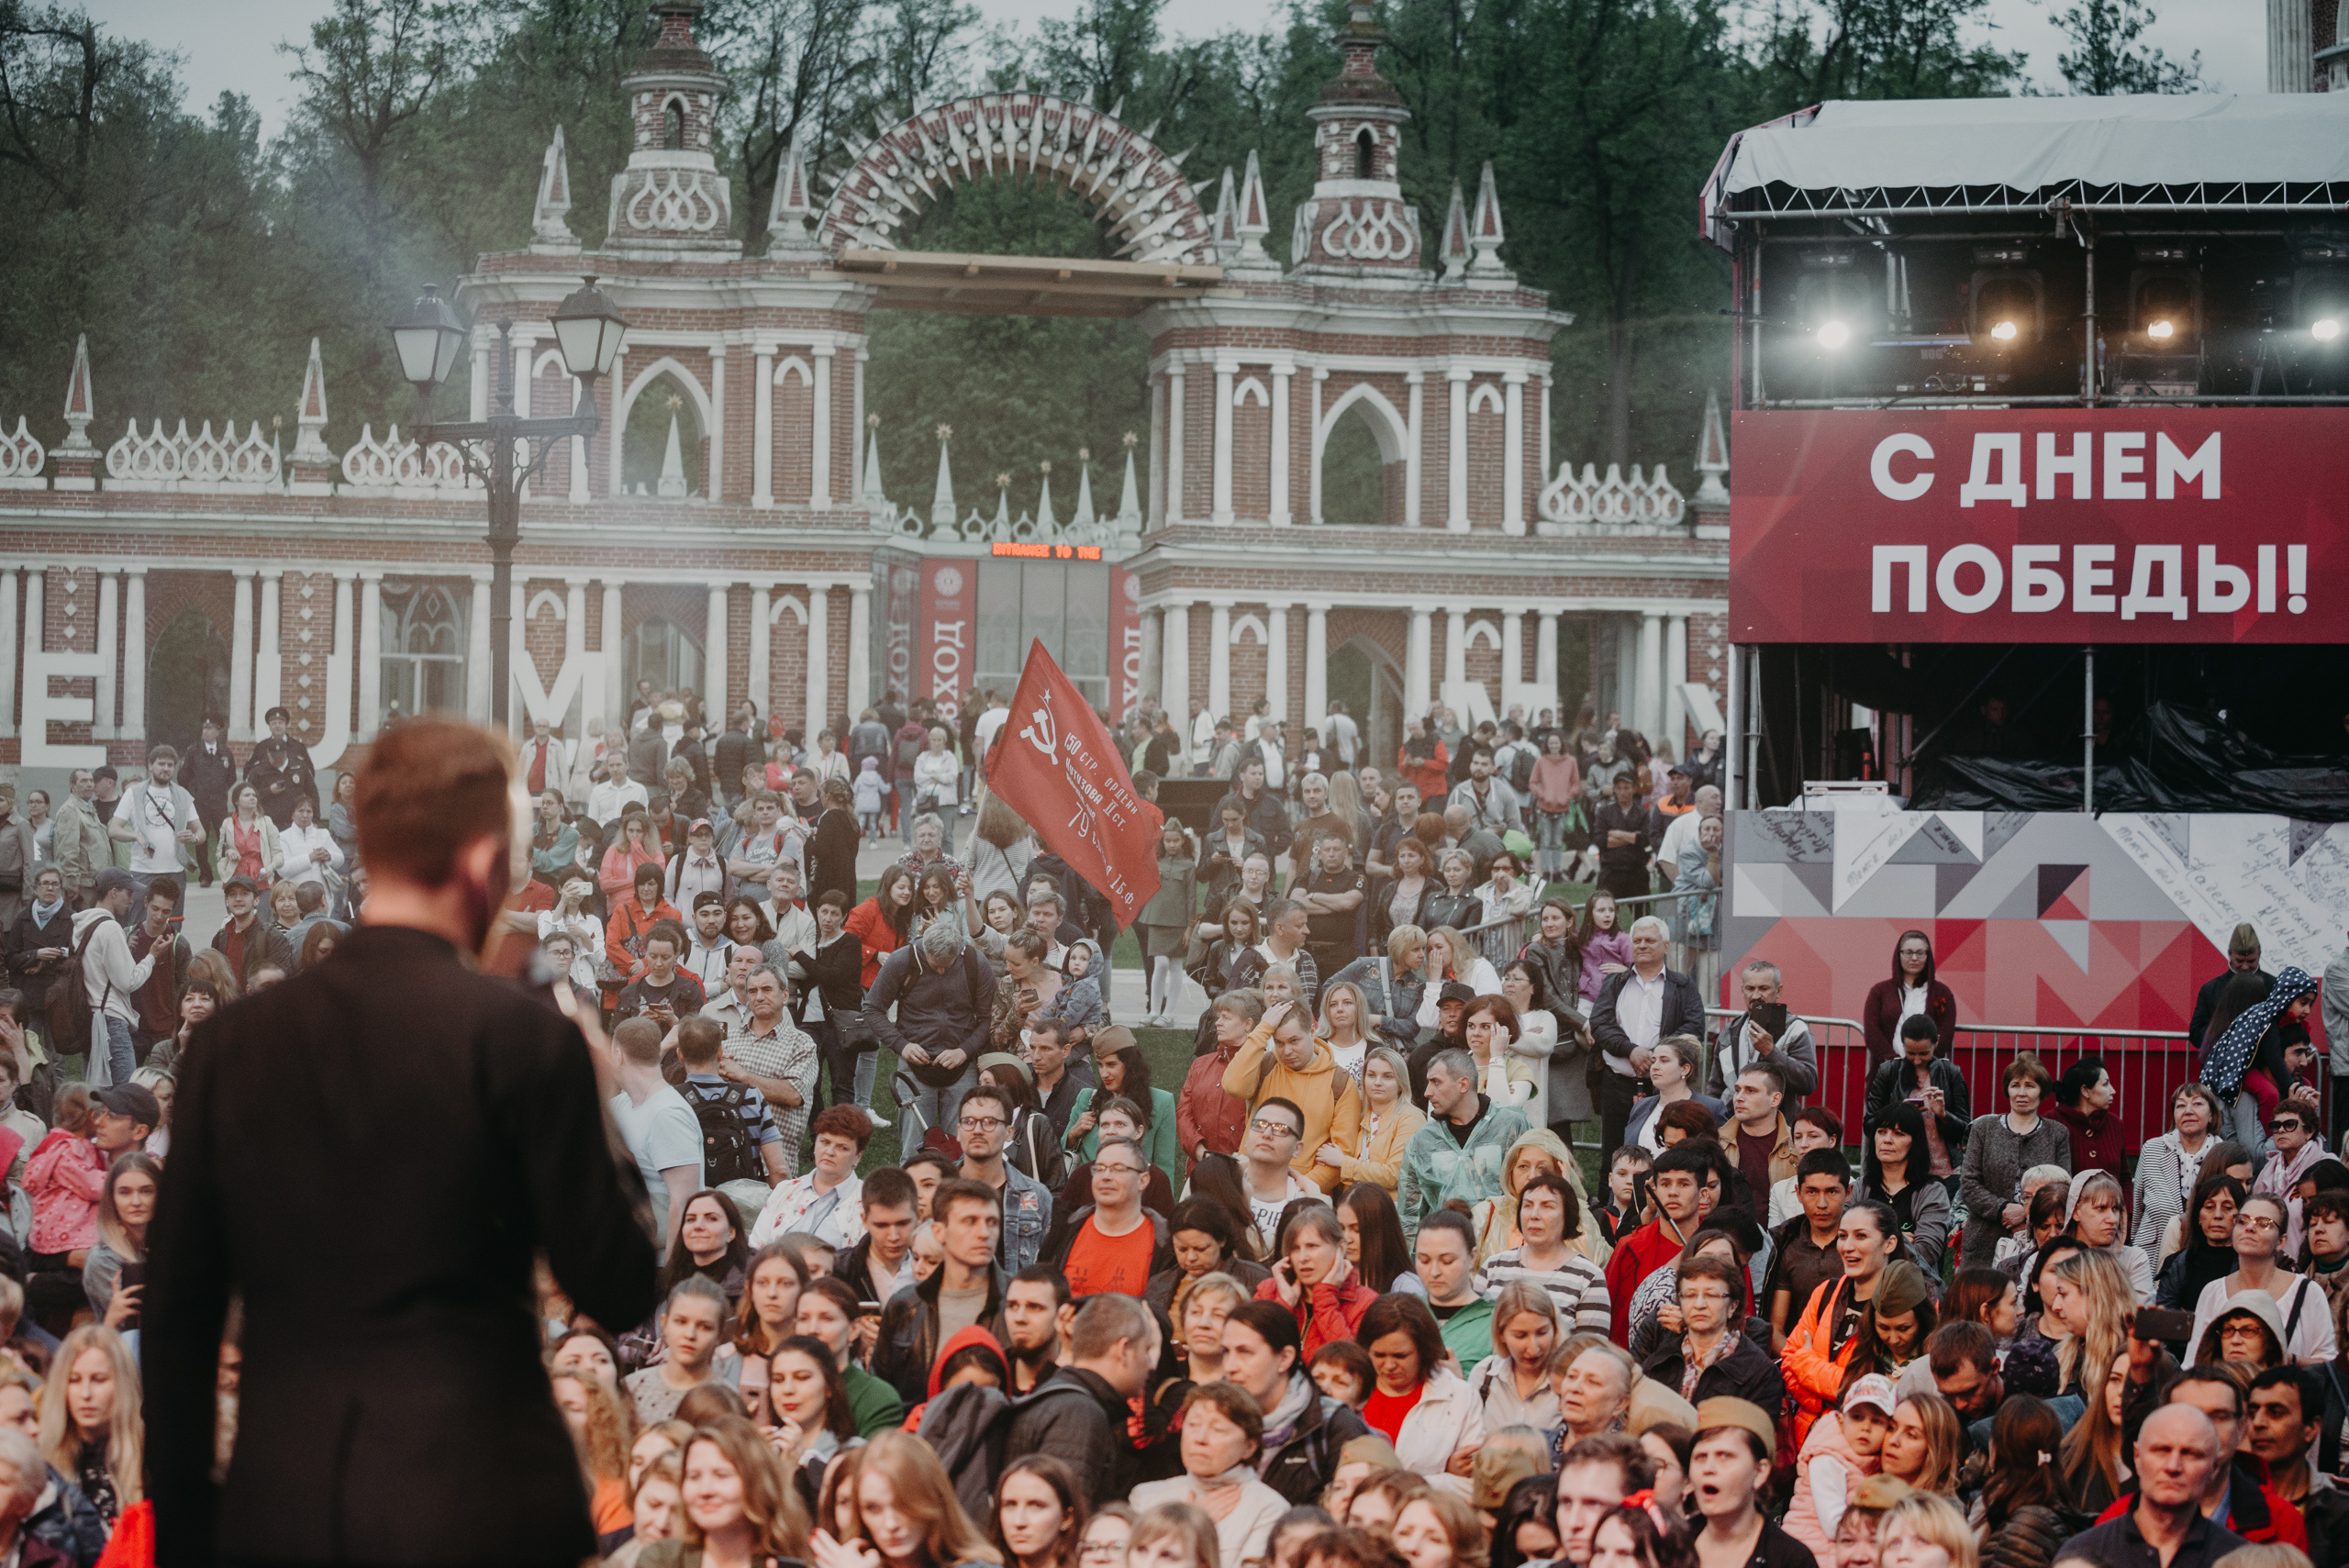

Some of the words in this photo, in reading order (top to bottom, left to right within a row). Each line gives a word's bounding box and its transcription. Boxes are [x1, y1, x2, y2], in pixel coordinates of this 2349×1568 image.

[1870, 432, 1935, 501] С
[1960, 431, 2222, 508] ДНЕМ
[992, 542, 1051, 558] ENTRANCE
[1055, 544, 1073, 559] TO
[1076, 546, 1102, 561] THE
[1872, 543, 2308, 621] ПОБЕДЫ!
[1064, 732, 1082, 756] 150
